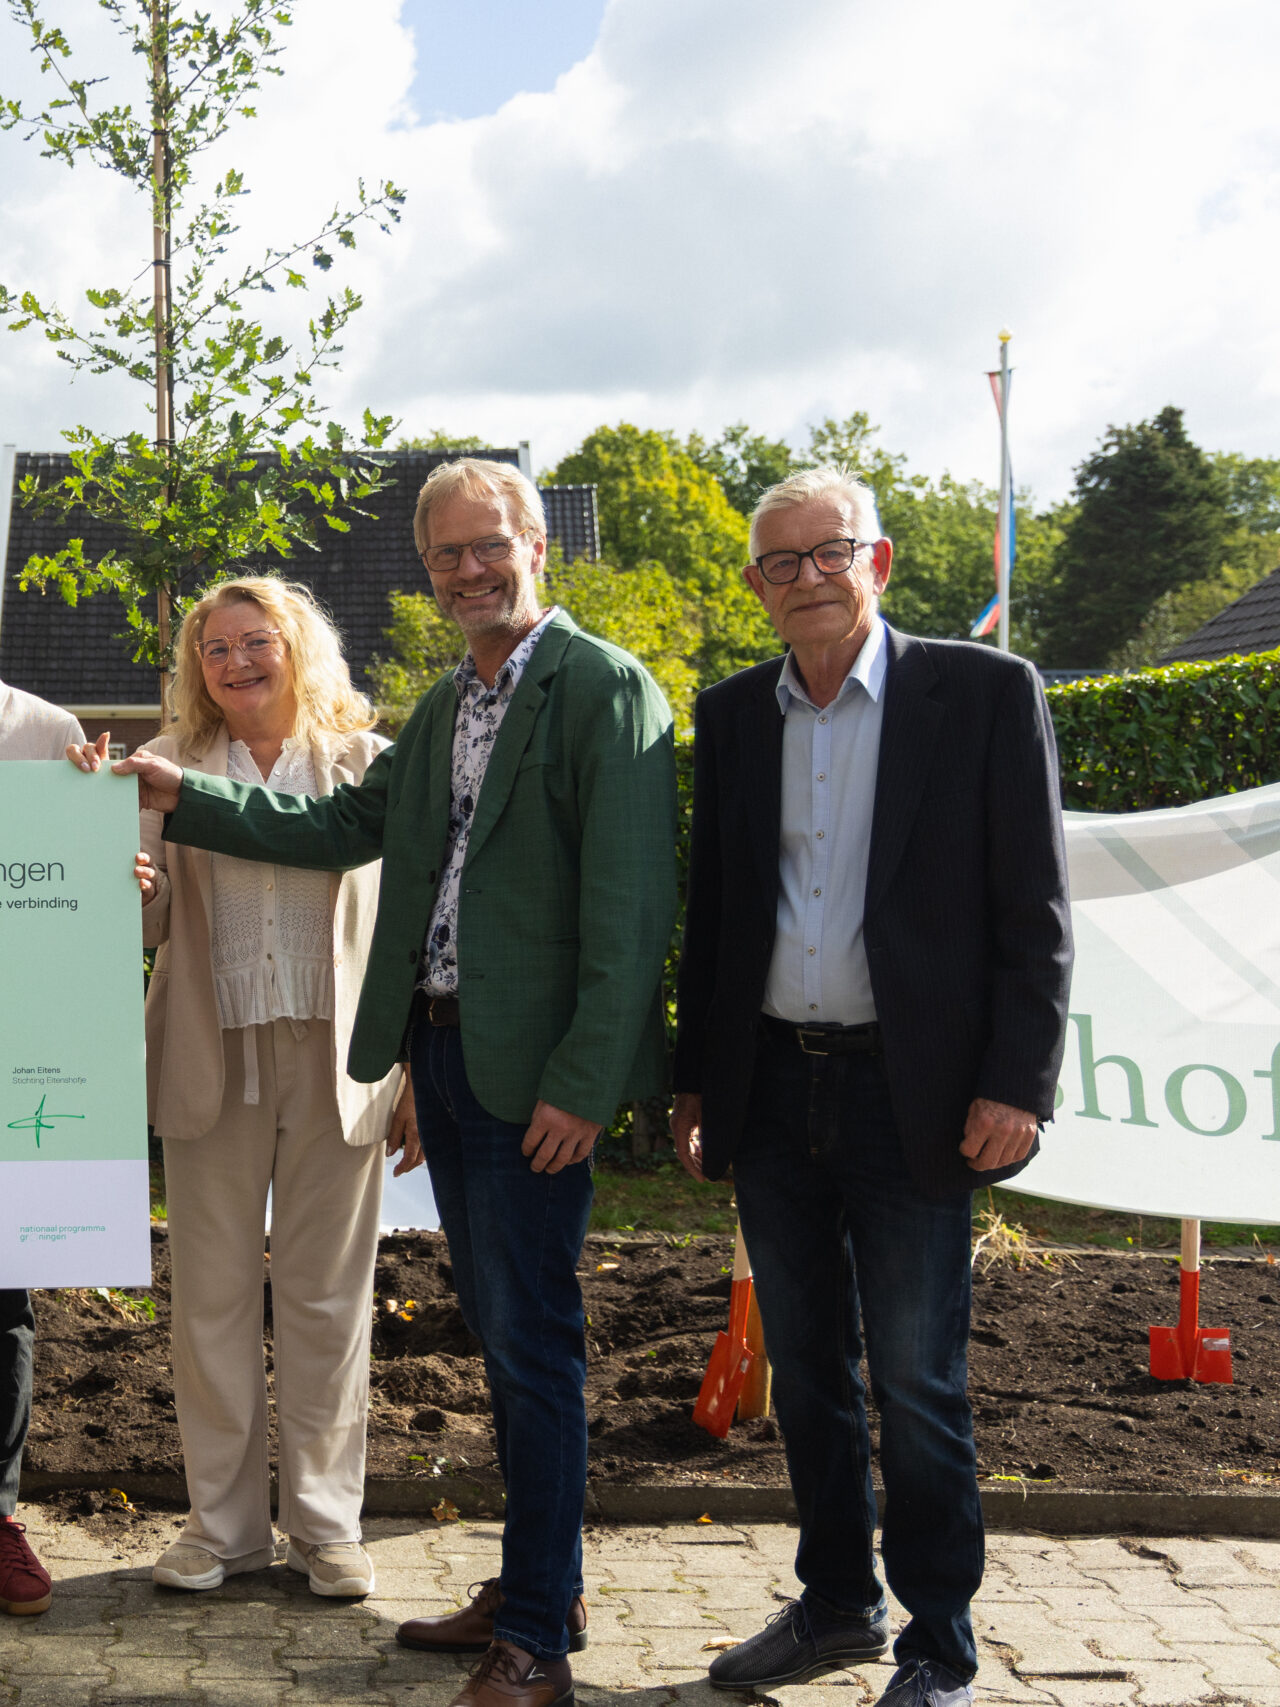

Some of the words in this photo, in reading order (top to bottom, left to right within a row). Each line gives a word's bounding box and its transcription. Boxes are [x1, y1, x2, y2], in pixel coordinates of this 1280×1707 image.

[6, 896, 79, 912] verbinding
[37, 1066, 61, 1074] Eitens
[12, 1076, 45, 1085] Stichting
[19, 1225, 58, 1233] nationaal
[58, 1224, 106, 1234] programma
